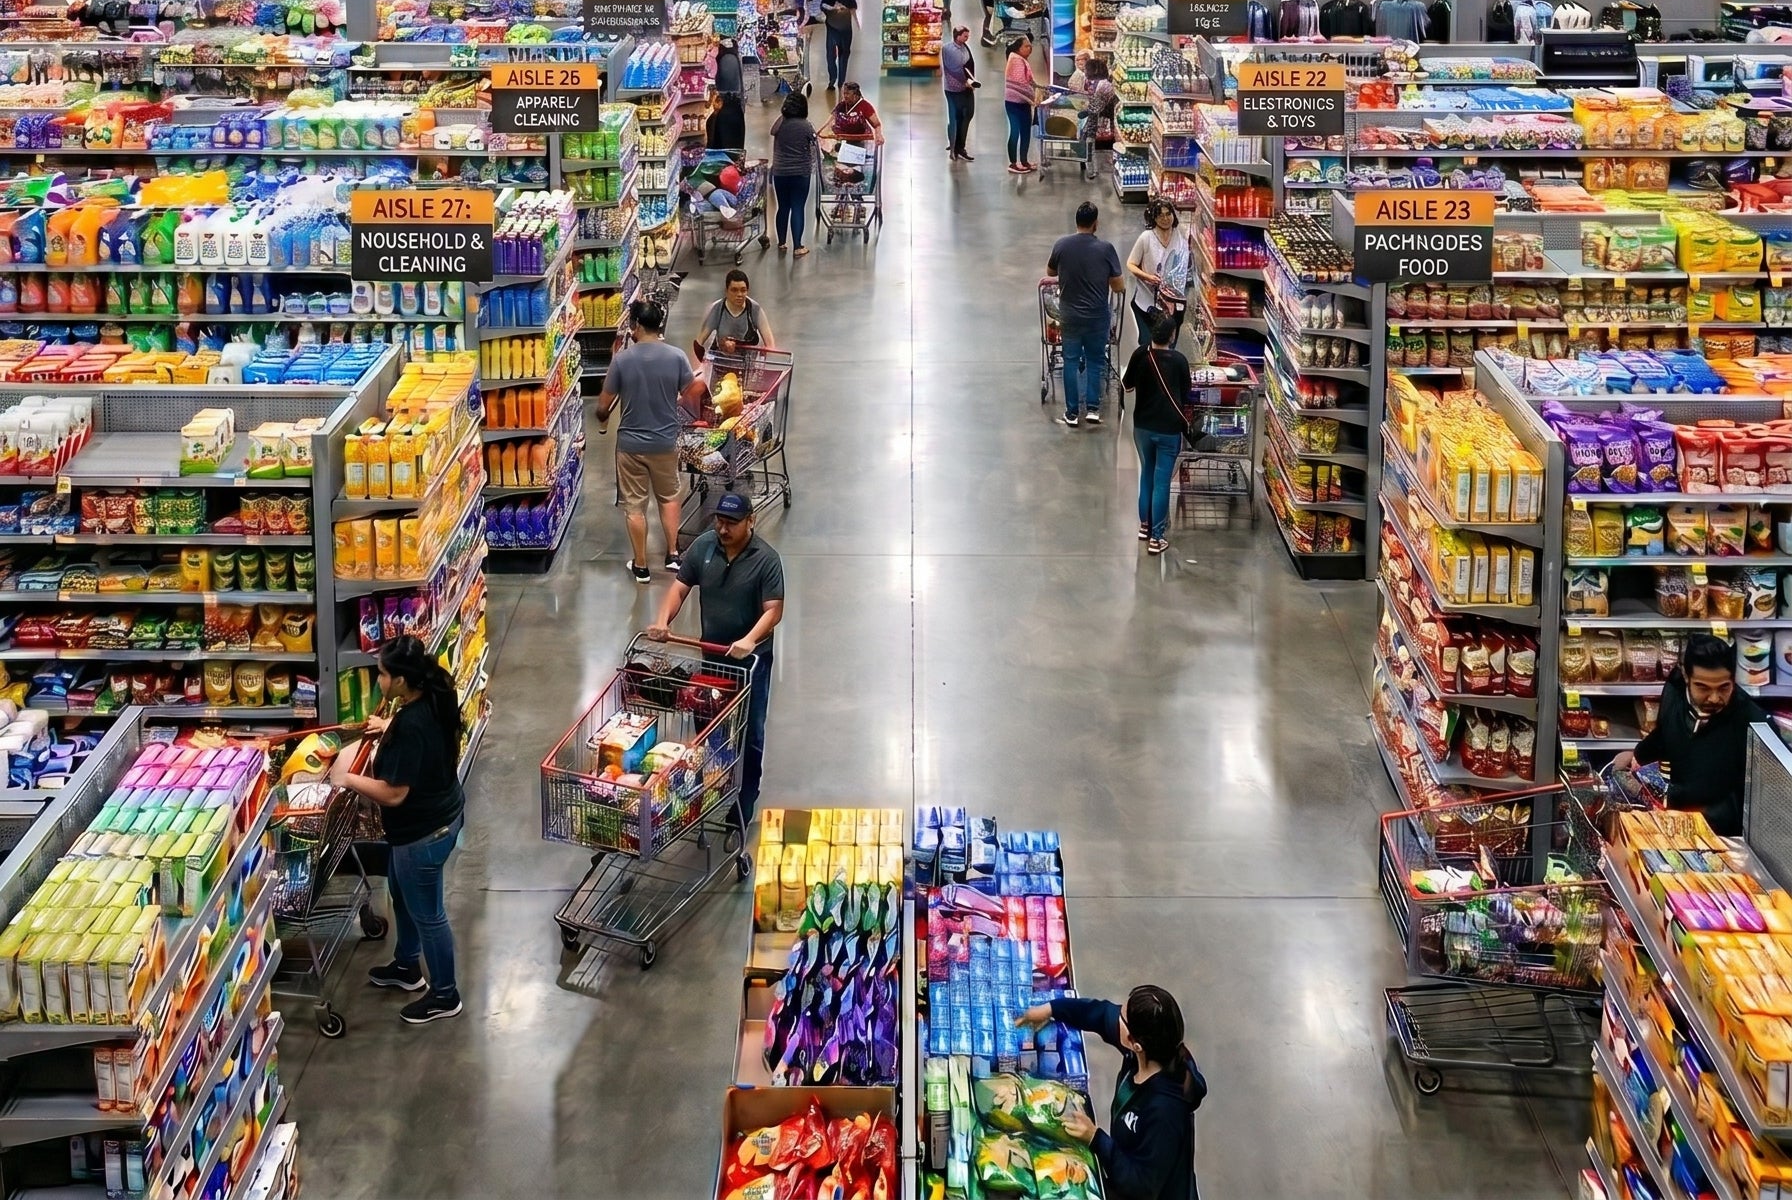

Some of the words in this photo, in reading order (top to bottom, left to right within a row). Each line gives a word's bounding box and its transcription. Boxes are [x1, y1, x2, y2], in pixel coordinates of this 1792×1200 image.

[507, 69, 554, 86] AISLE
[1252, 70, 1301, 87] AISLE
[1305, 70, 1327, 87] 22
[1243, 97, 1335, 111] ELESTRONICS
[514, 113, 580, 127] CLEANING
[1267, 114, 1279, 128] &
[1280, 114, 1316, 128] TOYS
[372, 198, 435, 219] AISLE
[441, 198, 471, 219] 27:
[1376, 200, 1438, 220] AISLE
[1444, 200, 1471, 220] 23
[360, 232, 467, 250] NOUSEHOLD
[470, 233, 485, 250] &
[379, 255, 467, 273] CLEANING
[1399, 258, 1449, 276] FOOD
